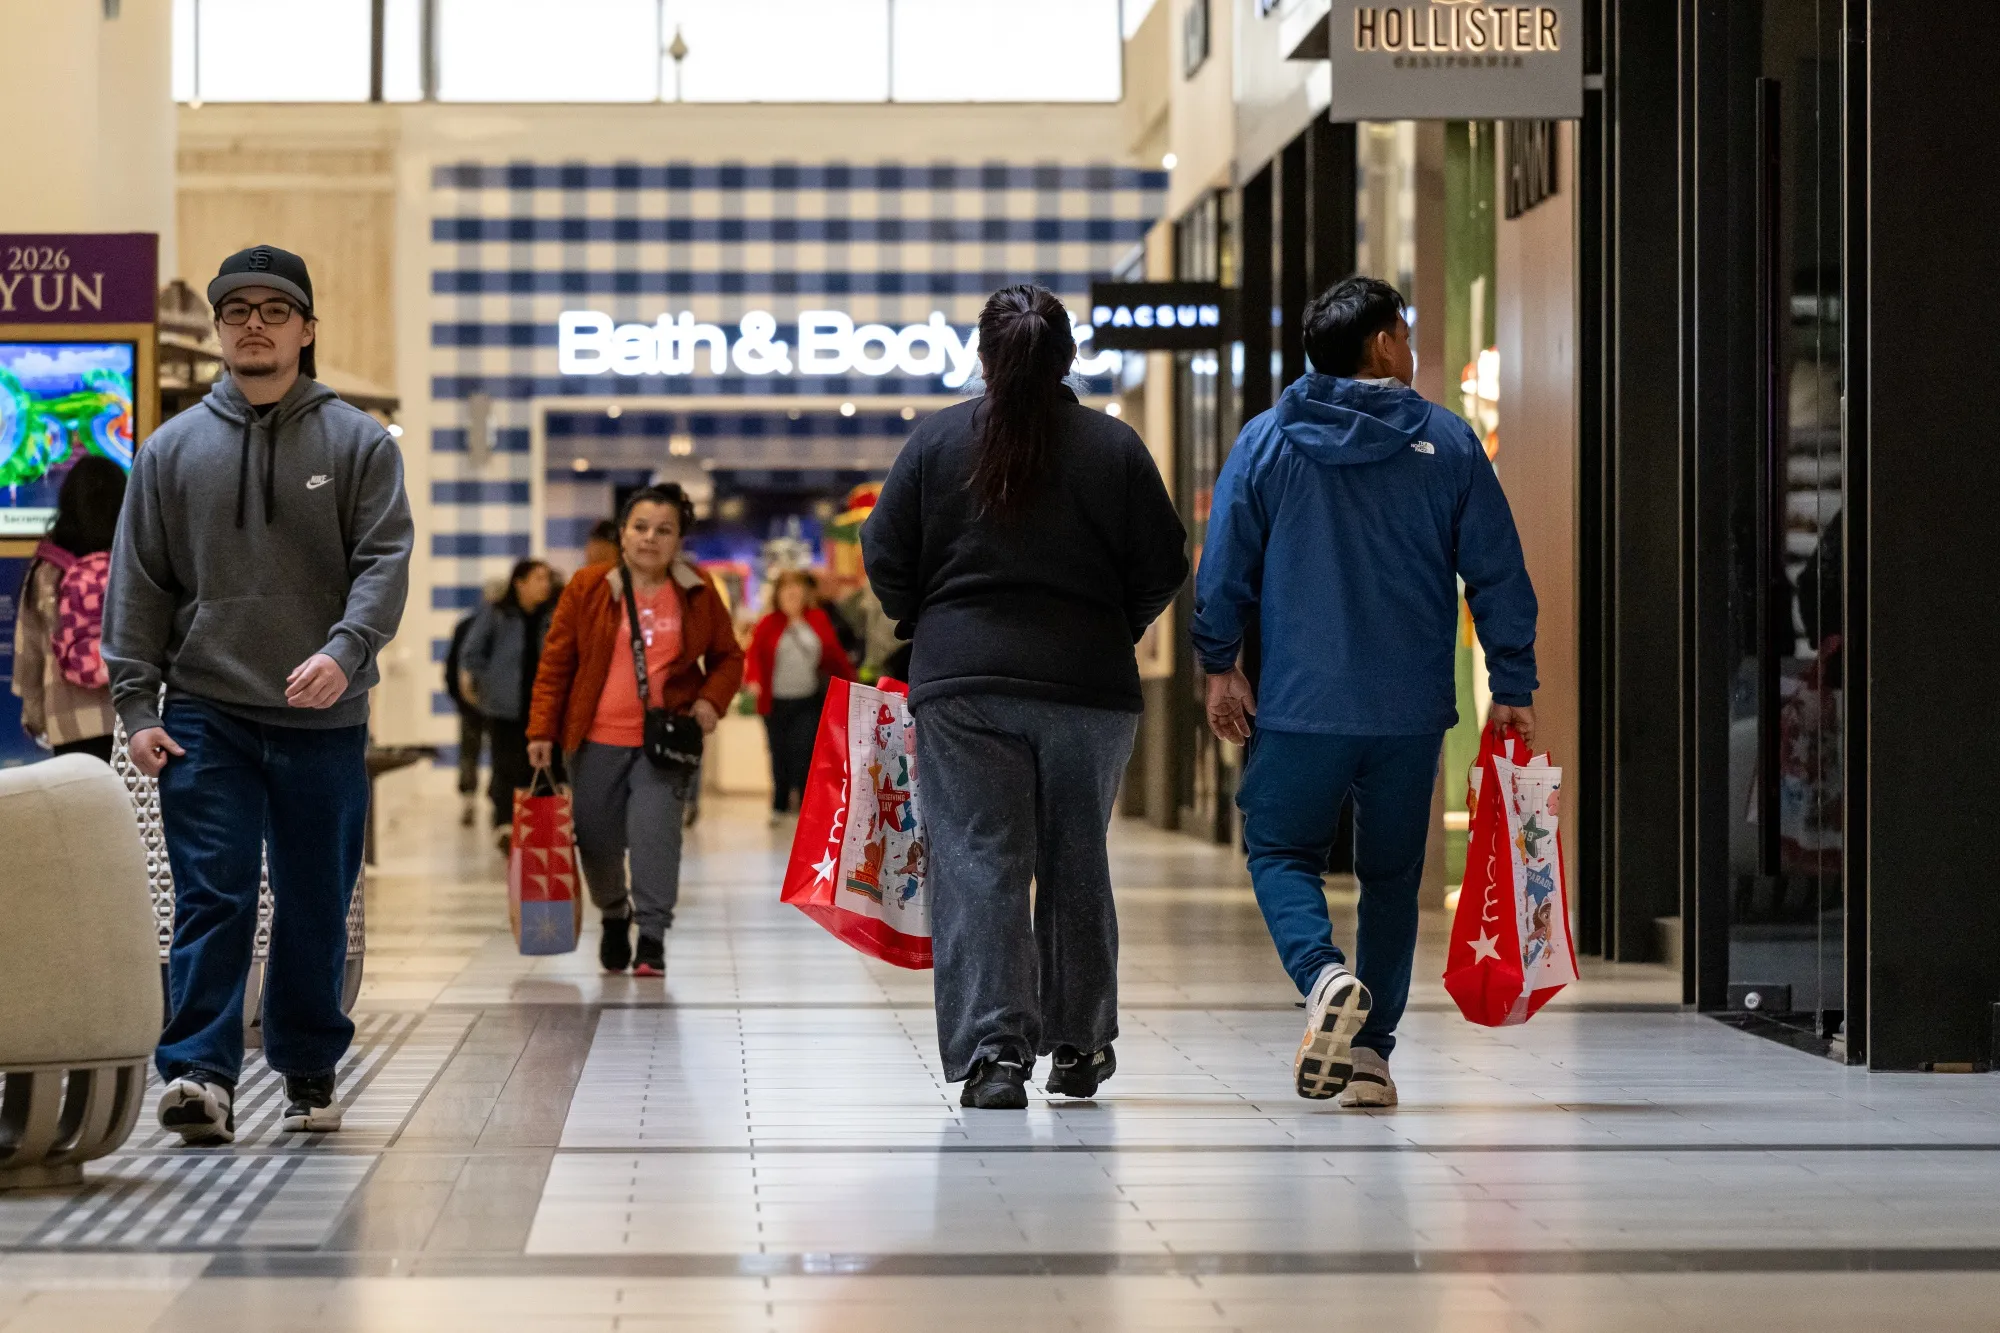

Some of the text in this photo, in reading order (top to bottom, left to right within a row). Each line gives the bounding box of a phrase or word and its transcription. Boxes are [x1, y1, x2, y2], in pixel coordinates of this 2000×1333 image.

[1356, 6, 1559, 50] HOLLISTER
[7, 246, 70, 271] 2026
[0, 272, 104, 312] YUN
[1092, 304, 1220, 328] PACSUN
[559, 310, 979, 388] Bath & Body
[1527, 870, 1553, 891] PARADE
